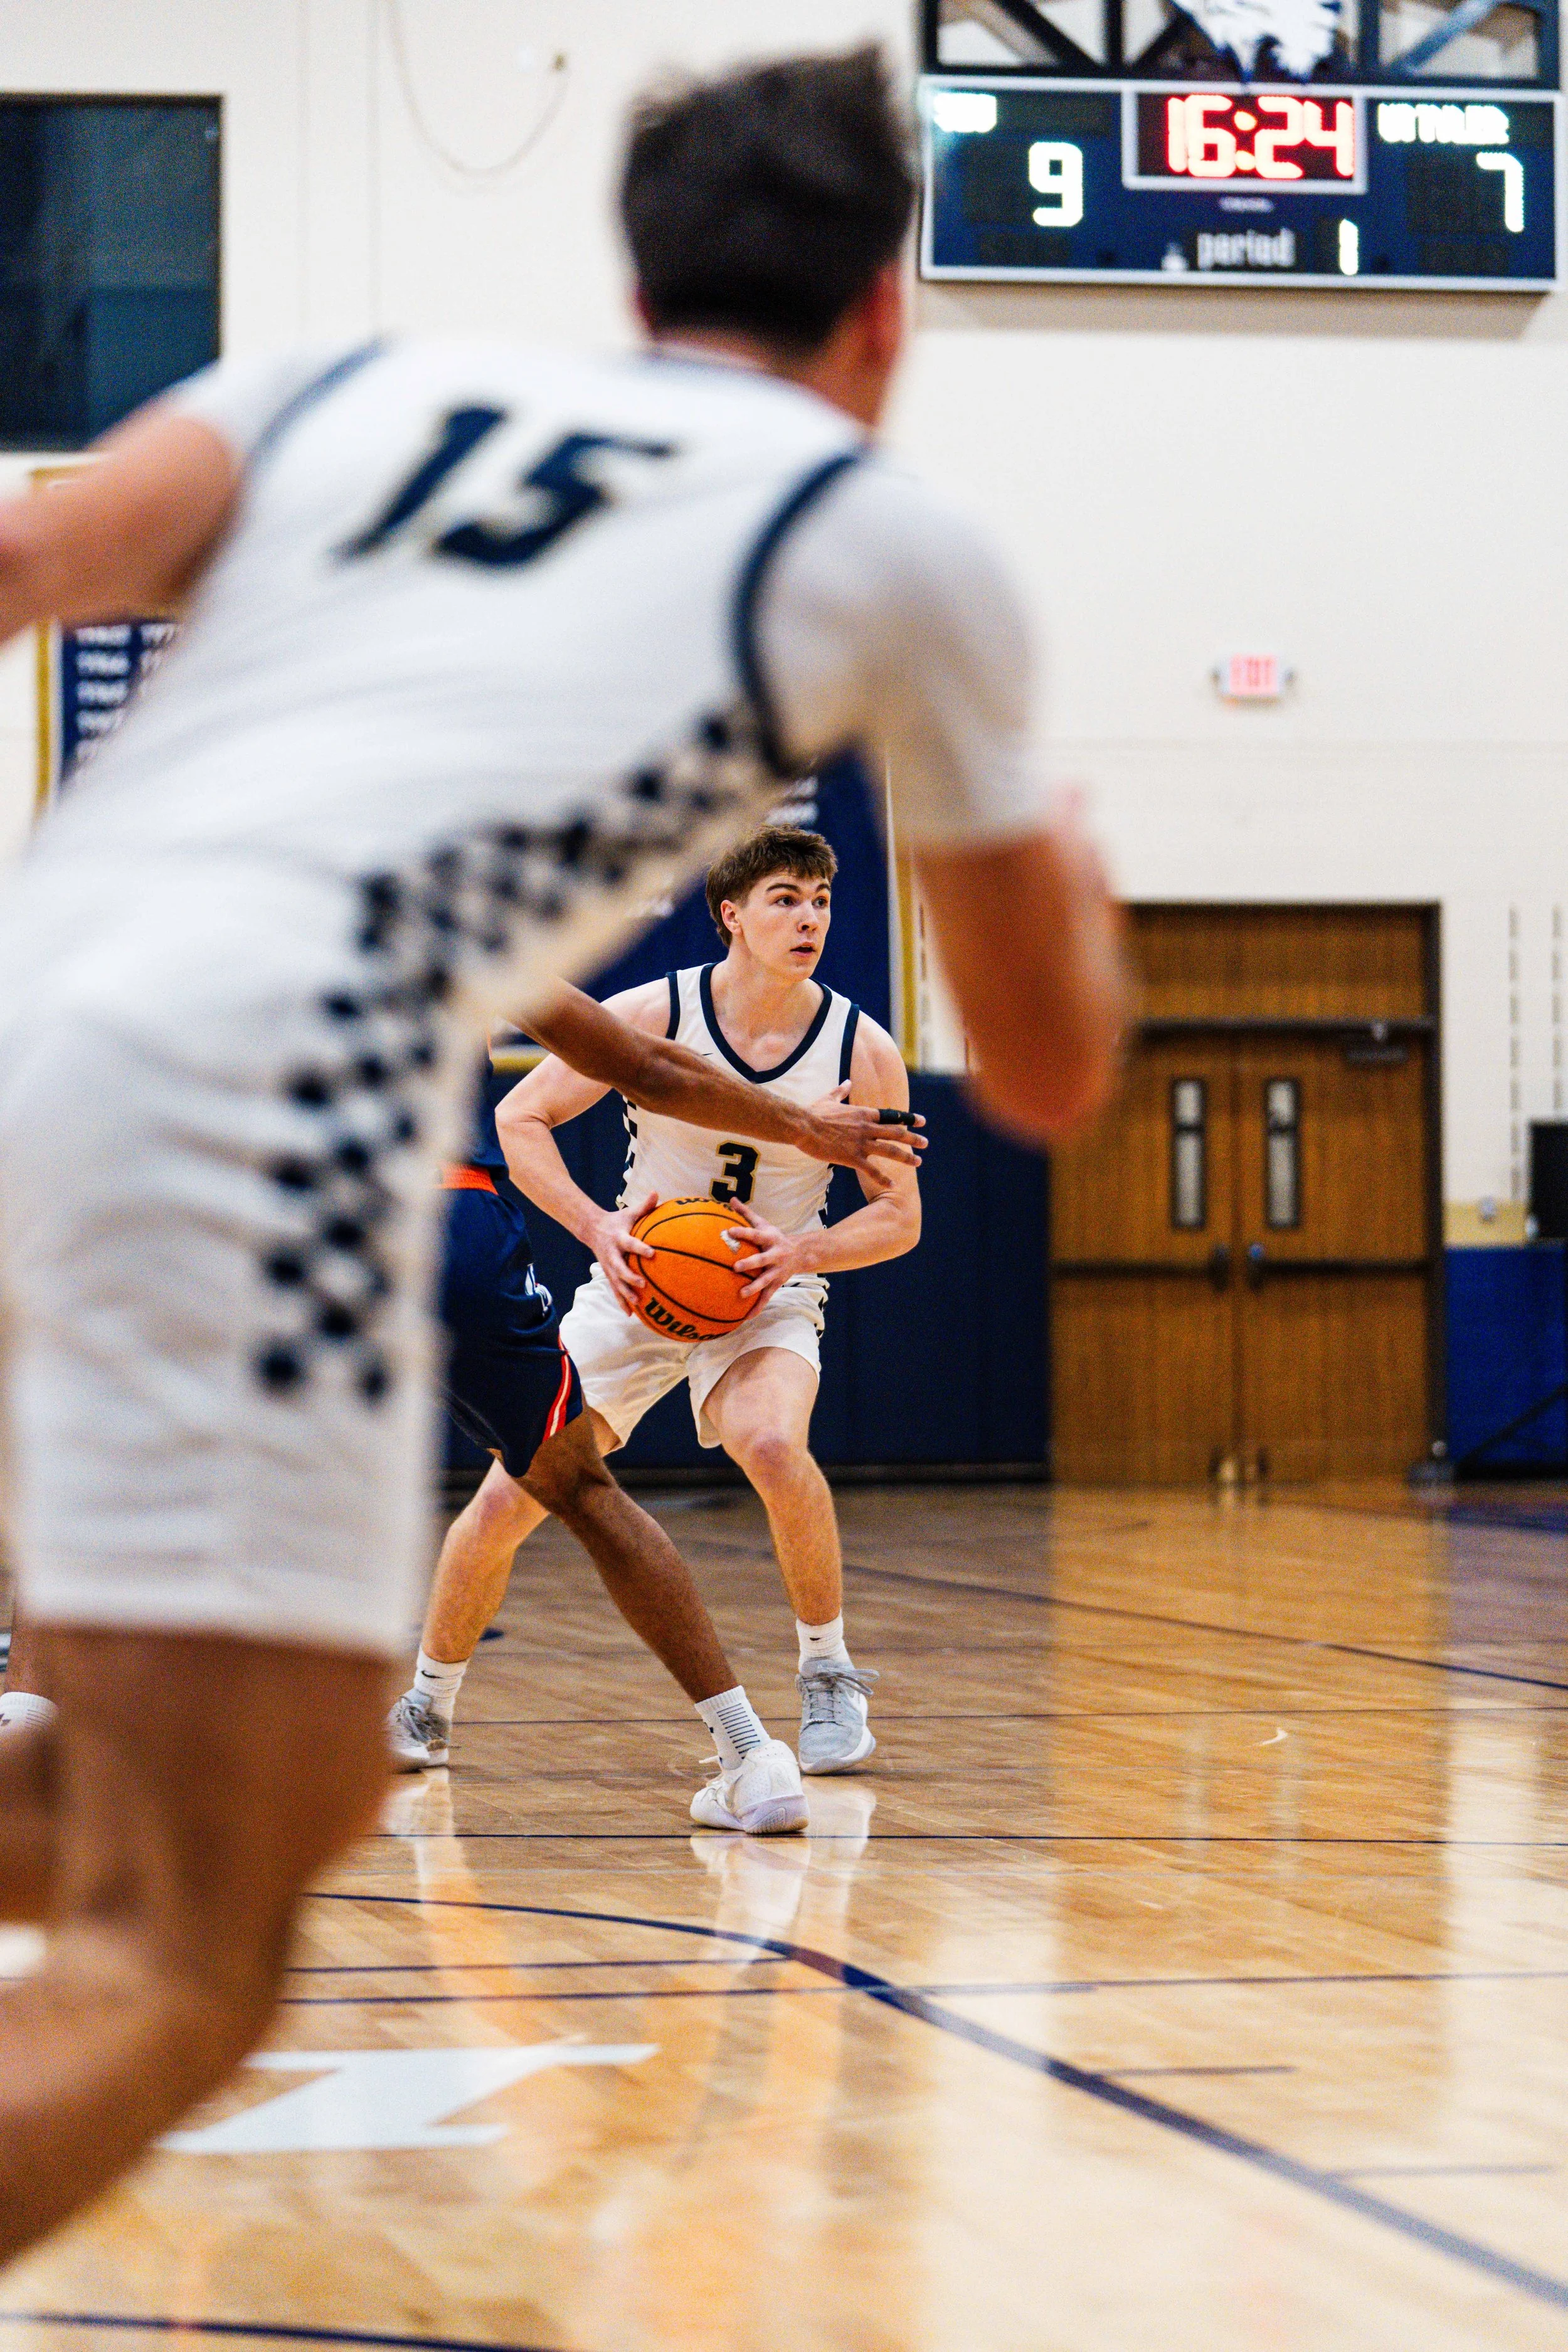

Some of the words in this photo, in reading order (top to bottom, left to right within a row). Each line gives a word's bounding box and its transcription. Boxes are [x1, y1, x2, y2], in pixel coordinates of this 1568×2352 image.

[1167, 93, 1355, 179] 16:24
[1027, 141, 1084, 227] 9
[1475, 151, 1525, 233] 7
[1197, 228, 1296, 270] period
[1338, 218, 1359, 276] 1
[329, 403, 679, 569] 15
[709, 1140, 761, 1204] 3
